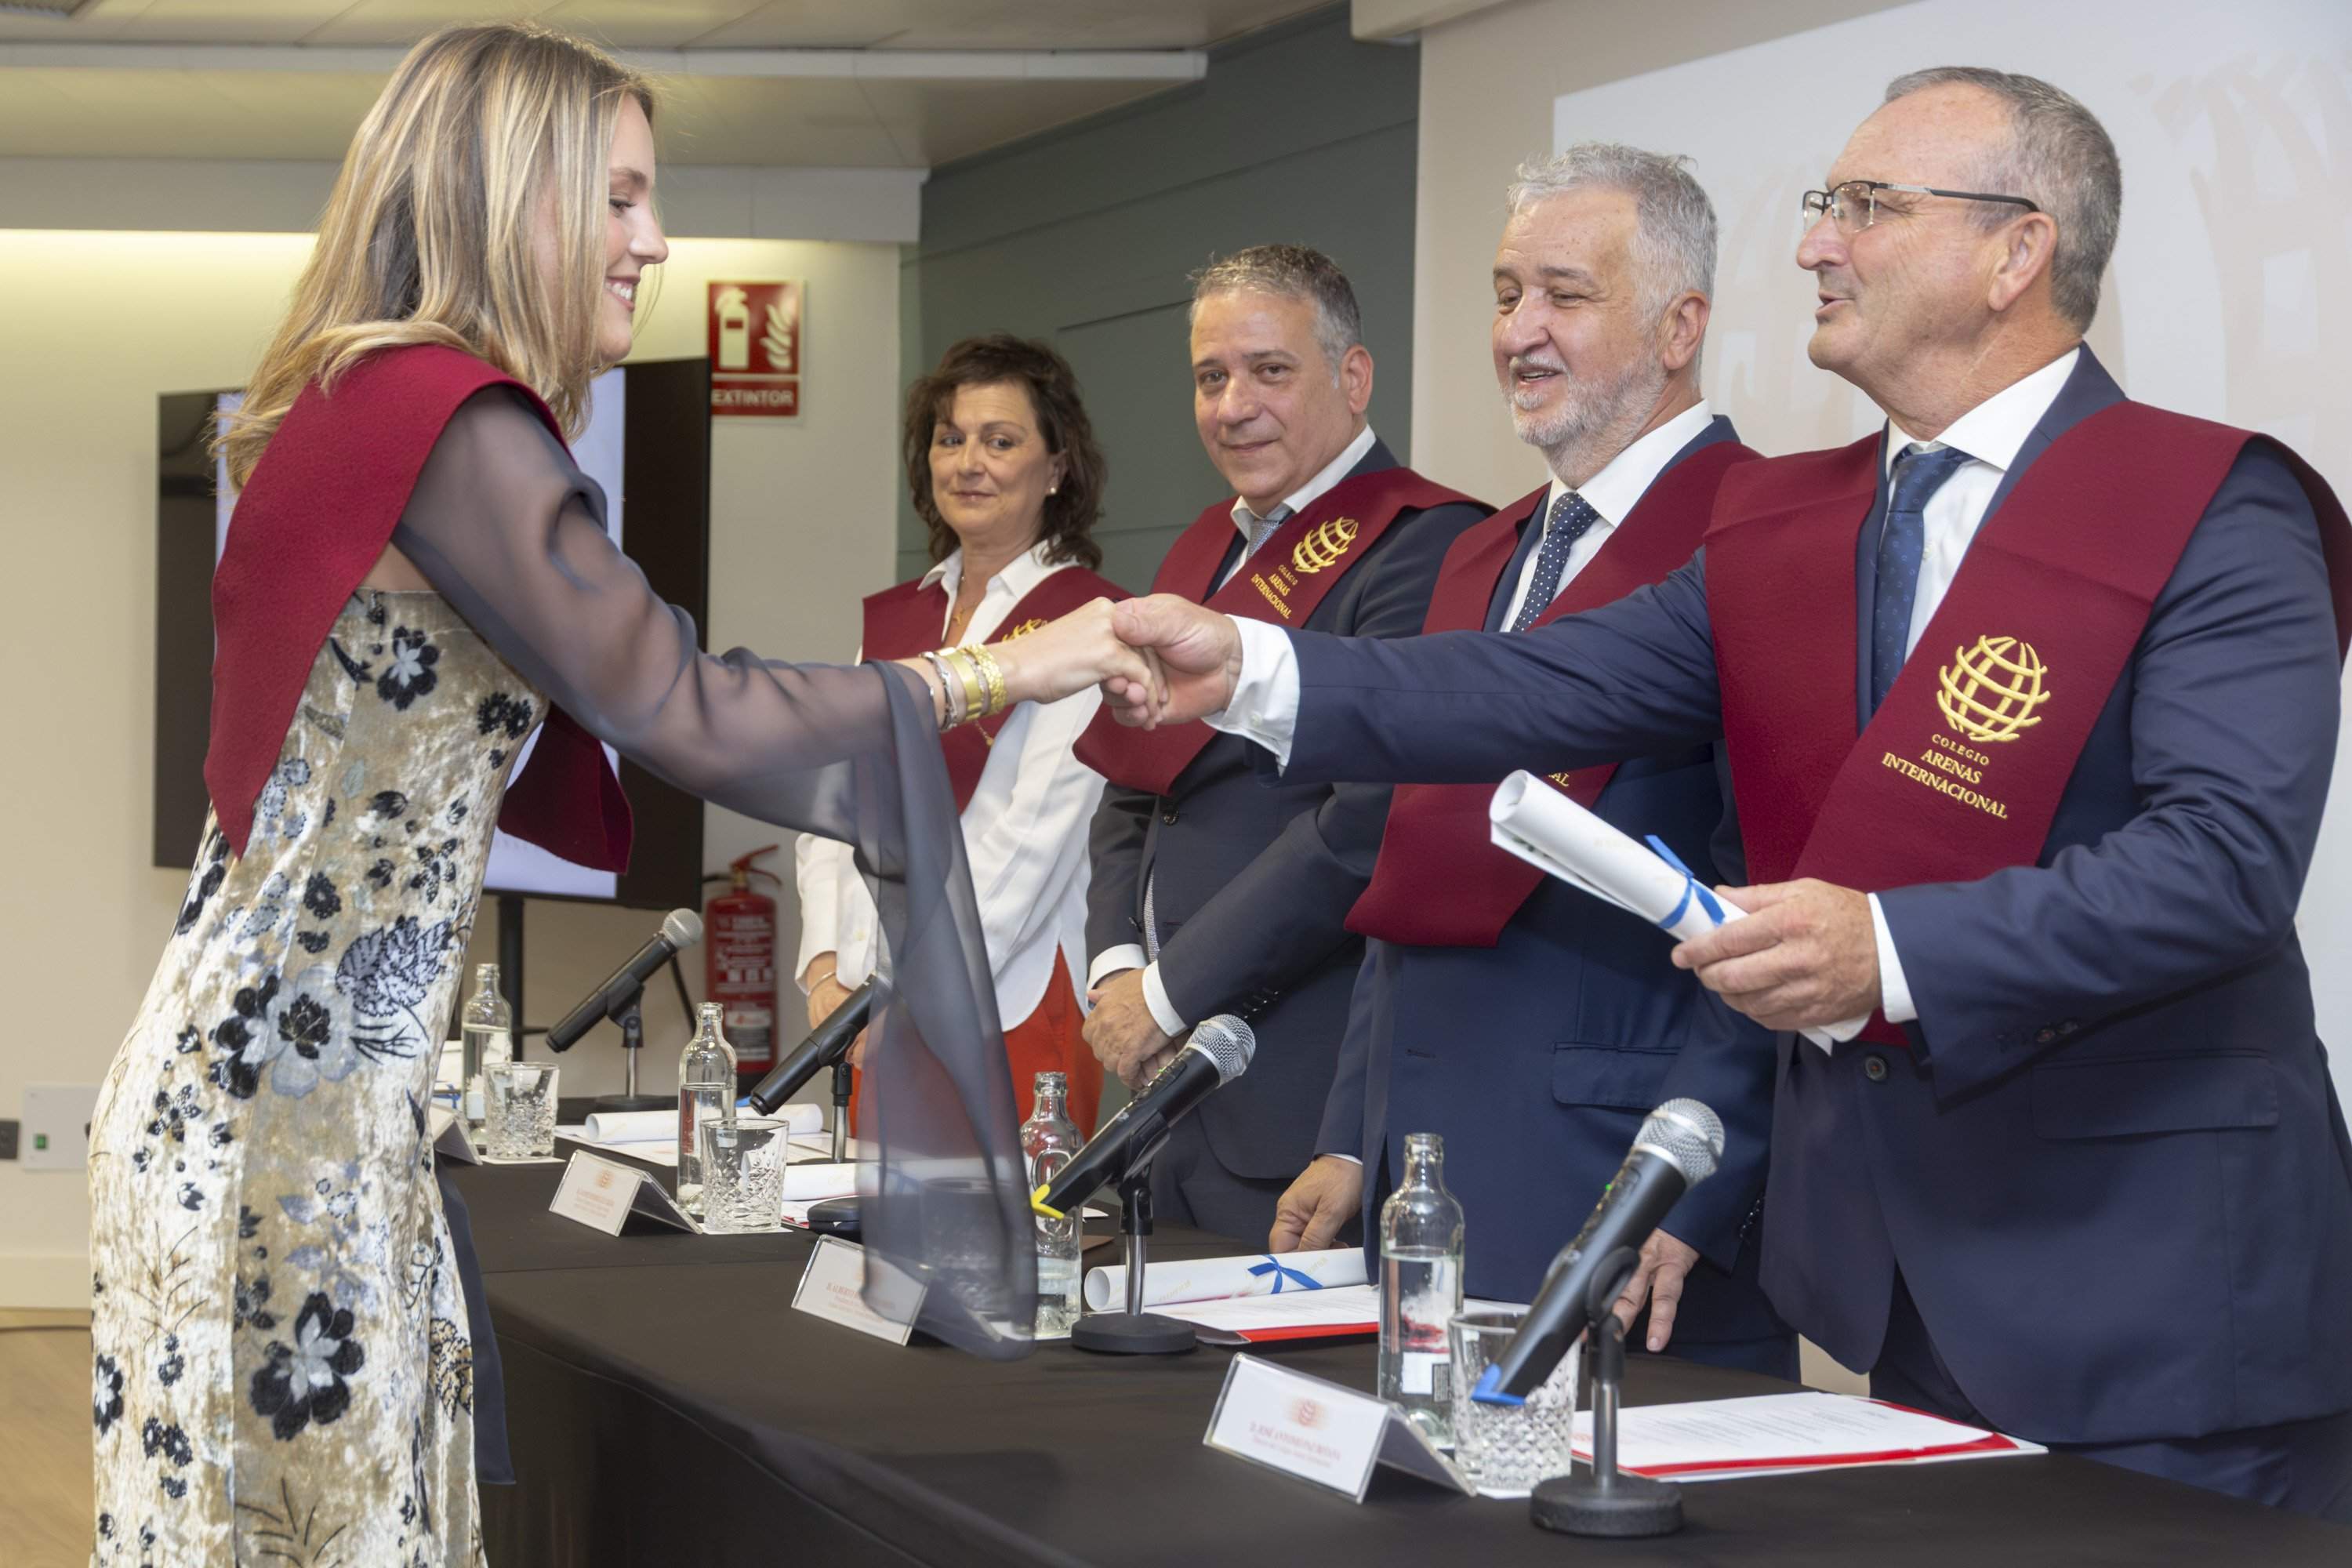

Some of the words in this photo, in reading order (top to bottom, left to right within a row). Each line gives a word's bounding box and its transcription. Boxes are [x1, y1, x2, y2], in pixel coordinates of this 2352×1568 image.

[1251, 573, 1291, 619] INTERNACIONAL
[1269, 573, 1290, 596] ARENAS
[1920, 749, 1983, 785] ARENAS
[1931, 733, 1990, 766] COLEGIO
[1881, 752, 2009, 819] INTERNACIONAL
